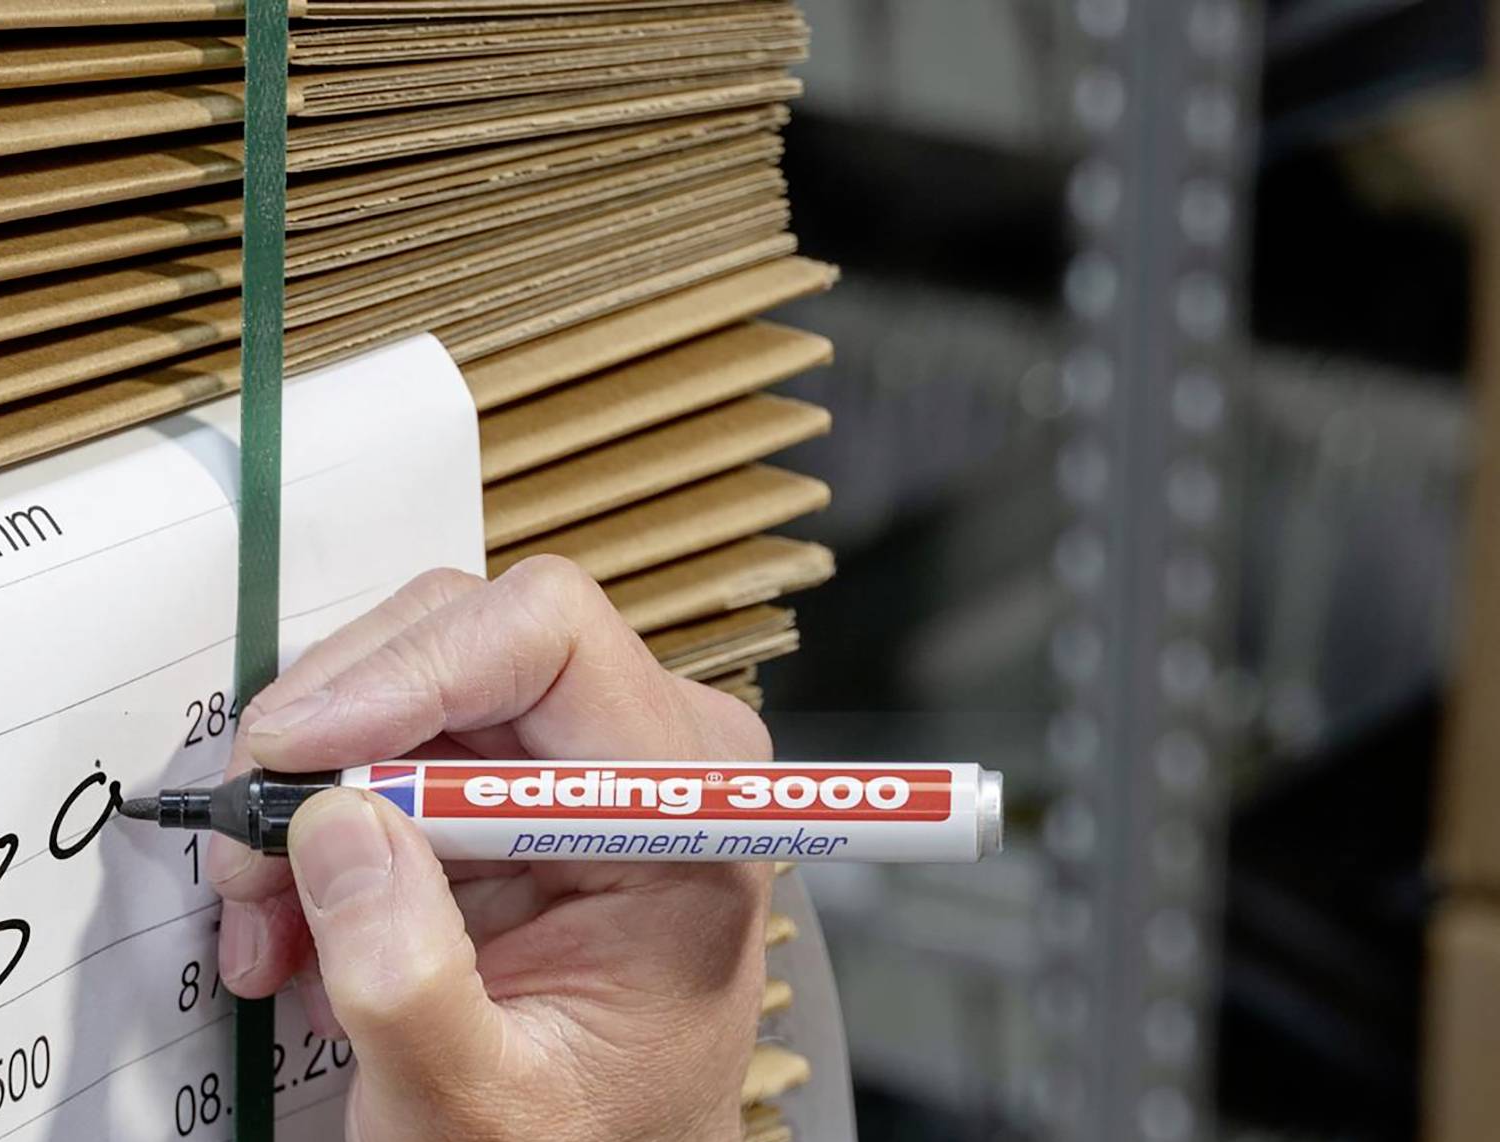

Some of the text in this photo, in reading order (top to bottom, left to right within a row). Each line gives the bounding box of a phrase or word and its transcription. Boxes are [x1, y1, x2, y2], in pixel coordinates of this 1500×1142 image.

[726, 774, 911, 811] 3000
[507, 827, 849, 858] permanent marker
